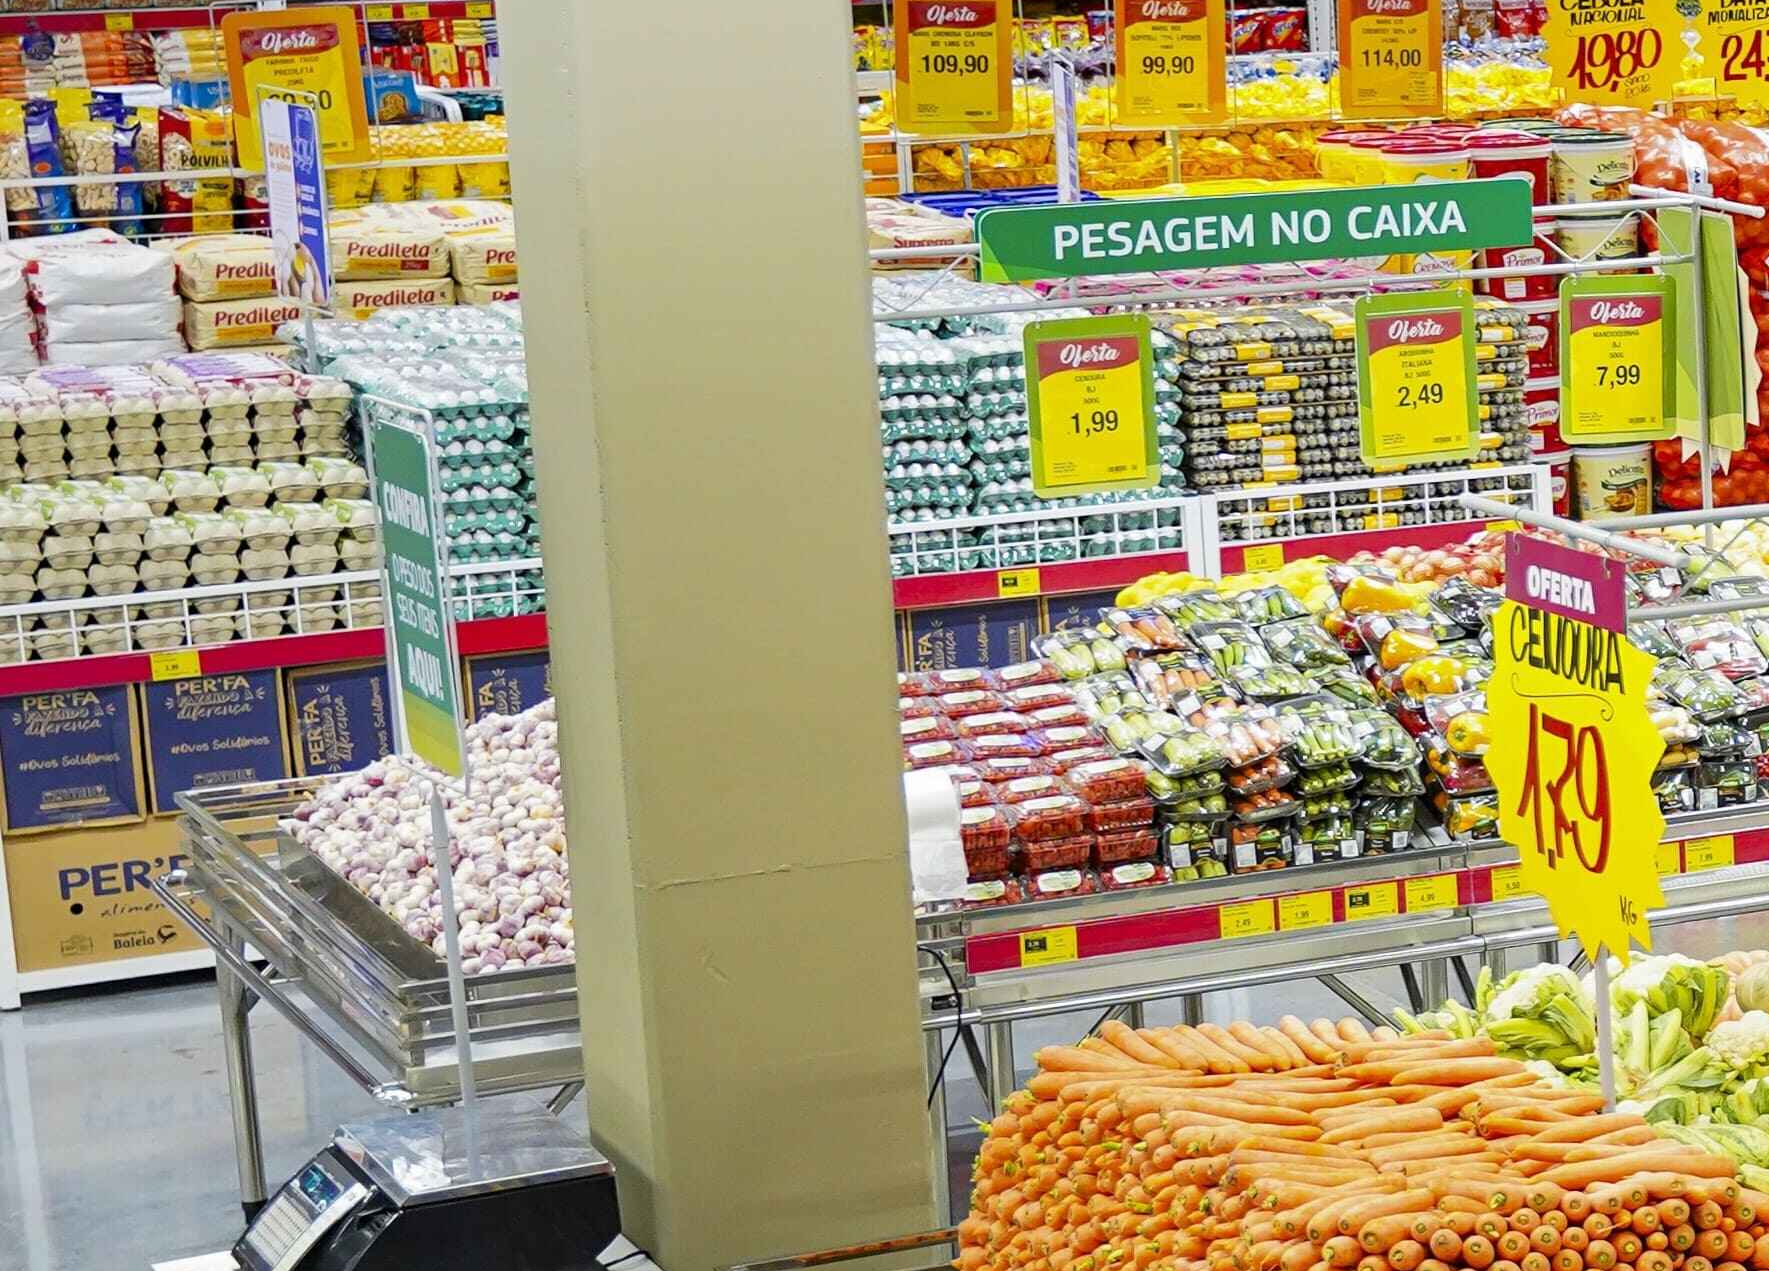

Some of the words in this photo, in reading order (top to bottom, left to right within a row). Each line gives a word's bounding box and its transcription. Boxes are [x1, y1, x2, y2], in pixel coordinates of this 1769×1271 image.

[921, 55, 989, 77] 109,90
[1142, 57, 1194, 76] 99,90
[1363, 49, 1421, 68] 114,00
[1568, 28, 1662, 92] 19,80
[1054, 213, 1254, 261] PESAGEM
[1271, 208, 1330, 245] NO
[1347, 201, 1466, 240] CAIXA
[347, 241, 430, 259] Predileta
[352, 289, 435, 309] Predileta
[1590, 301, 1645, 321] Oferta
[214, 306, 299, 326] Predileta
[1388, 320, 1445, 342] Oferta
[1060, 343, 1120, 367] Oferta
[1596, 364, 1641, 390] 7,99
[1398, 383, 1443, 409] 2,49
[1072, 410, 1118, 437] 1,99
[384, 481, 430, 537] CONFIRA
[1527, 565, 1595, 614] OFERTA
[1510, 605, 1625, 695] CENOURA
[1517, 703, 1611, 873] 1,79
[1620, 895, 1637, 926] KG
